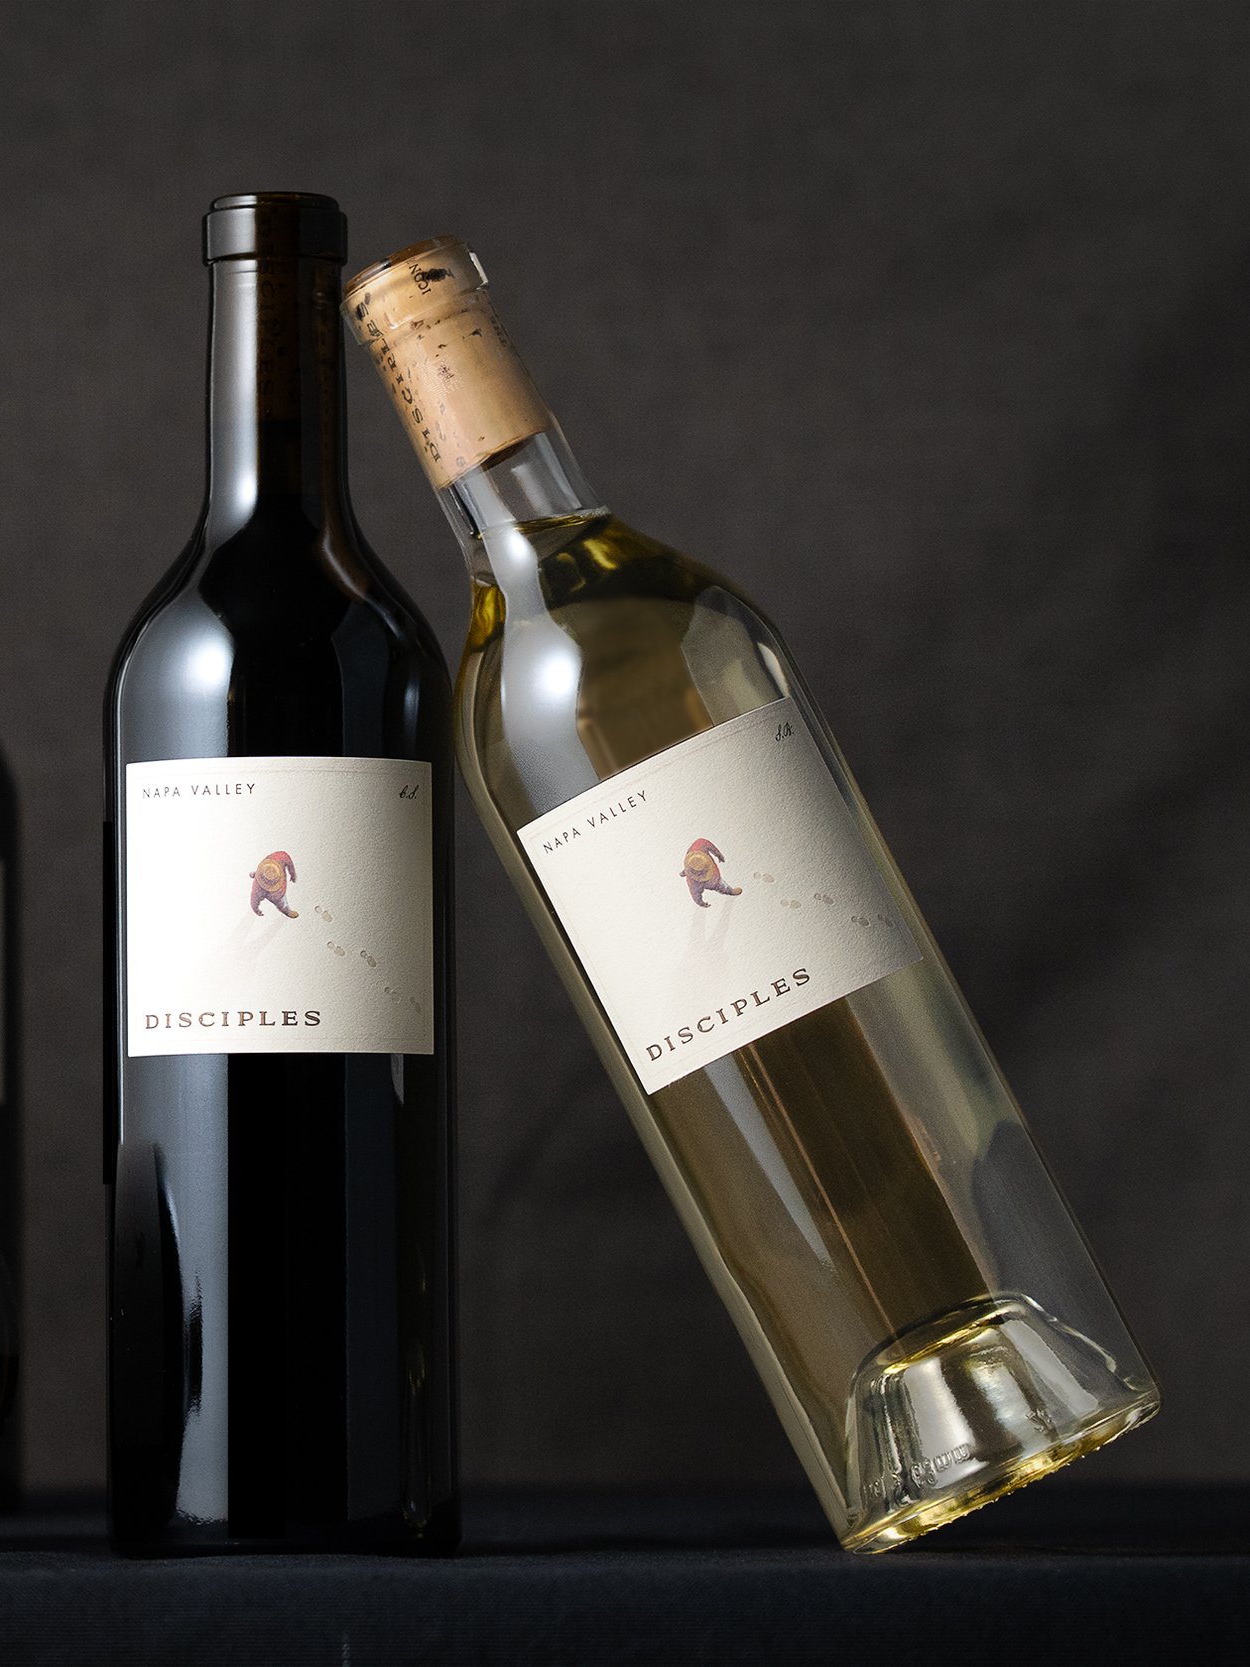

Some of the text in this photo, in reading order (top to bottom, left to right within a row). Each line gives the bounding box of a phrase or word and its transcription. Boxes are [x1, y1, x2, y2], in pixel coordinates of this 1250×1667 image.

[408, 262, 433, 296] ICON
[355, 301, 442, 463] DISCIPLES
[143, 783, 256, 799] NAPA VALLEY
[542, 789, 648, 854] NAPA VALLEY
[145, 1009, 323, 1029] DISCIPLES
[645, 967, 811, 1061] DISCIPLES
